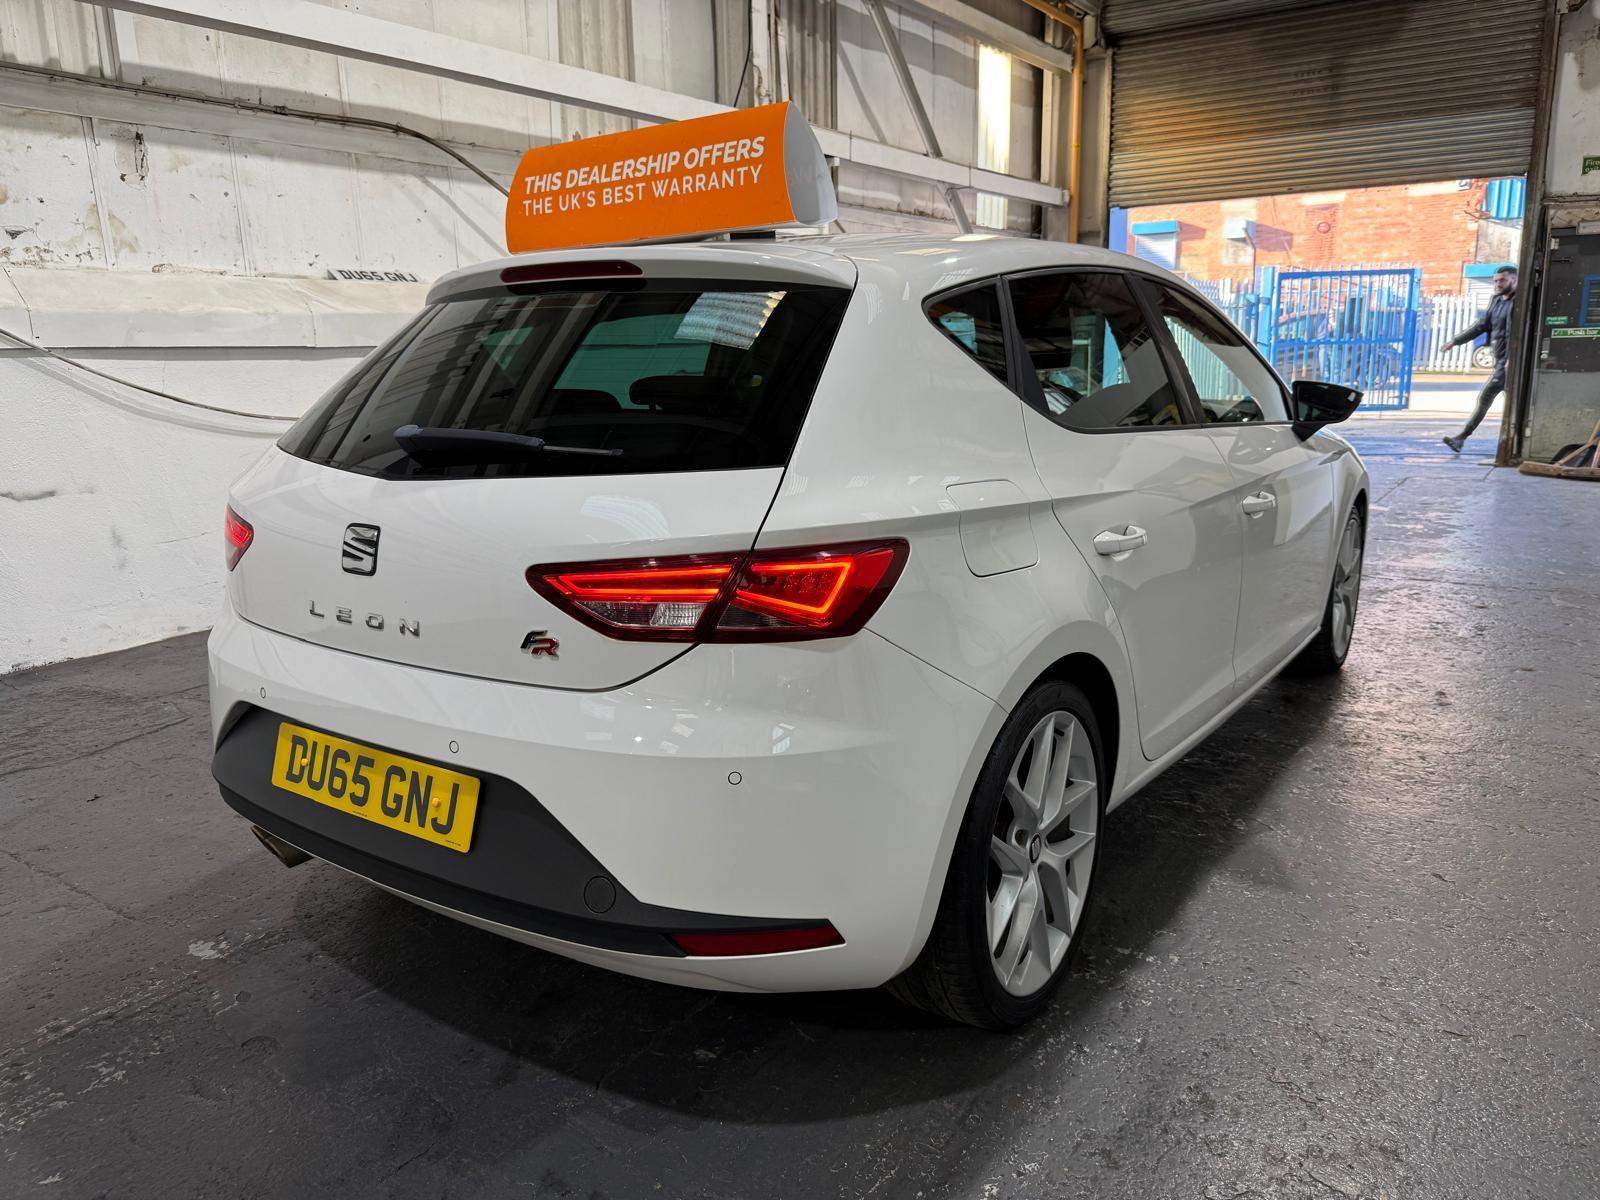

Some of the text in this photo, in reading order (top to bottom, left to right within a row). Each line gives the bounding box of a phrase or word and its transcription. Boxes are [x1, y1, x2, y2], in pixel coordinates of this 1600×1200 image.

[524, 136, 765, 195] THIS DEALERSHIP OFFERS
[523, 164, 762, 216] THE UK'S BEST WARRANTY
[337, 269, 418, 283] DU65 GNJ
[309, 600, 420, 638] LEON
[520, 630, 560, 658] FR
[285, 734, 460, 836] DU65 GNJ
